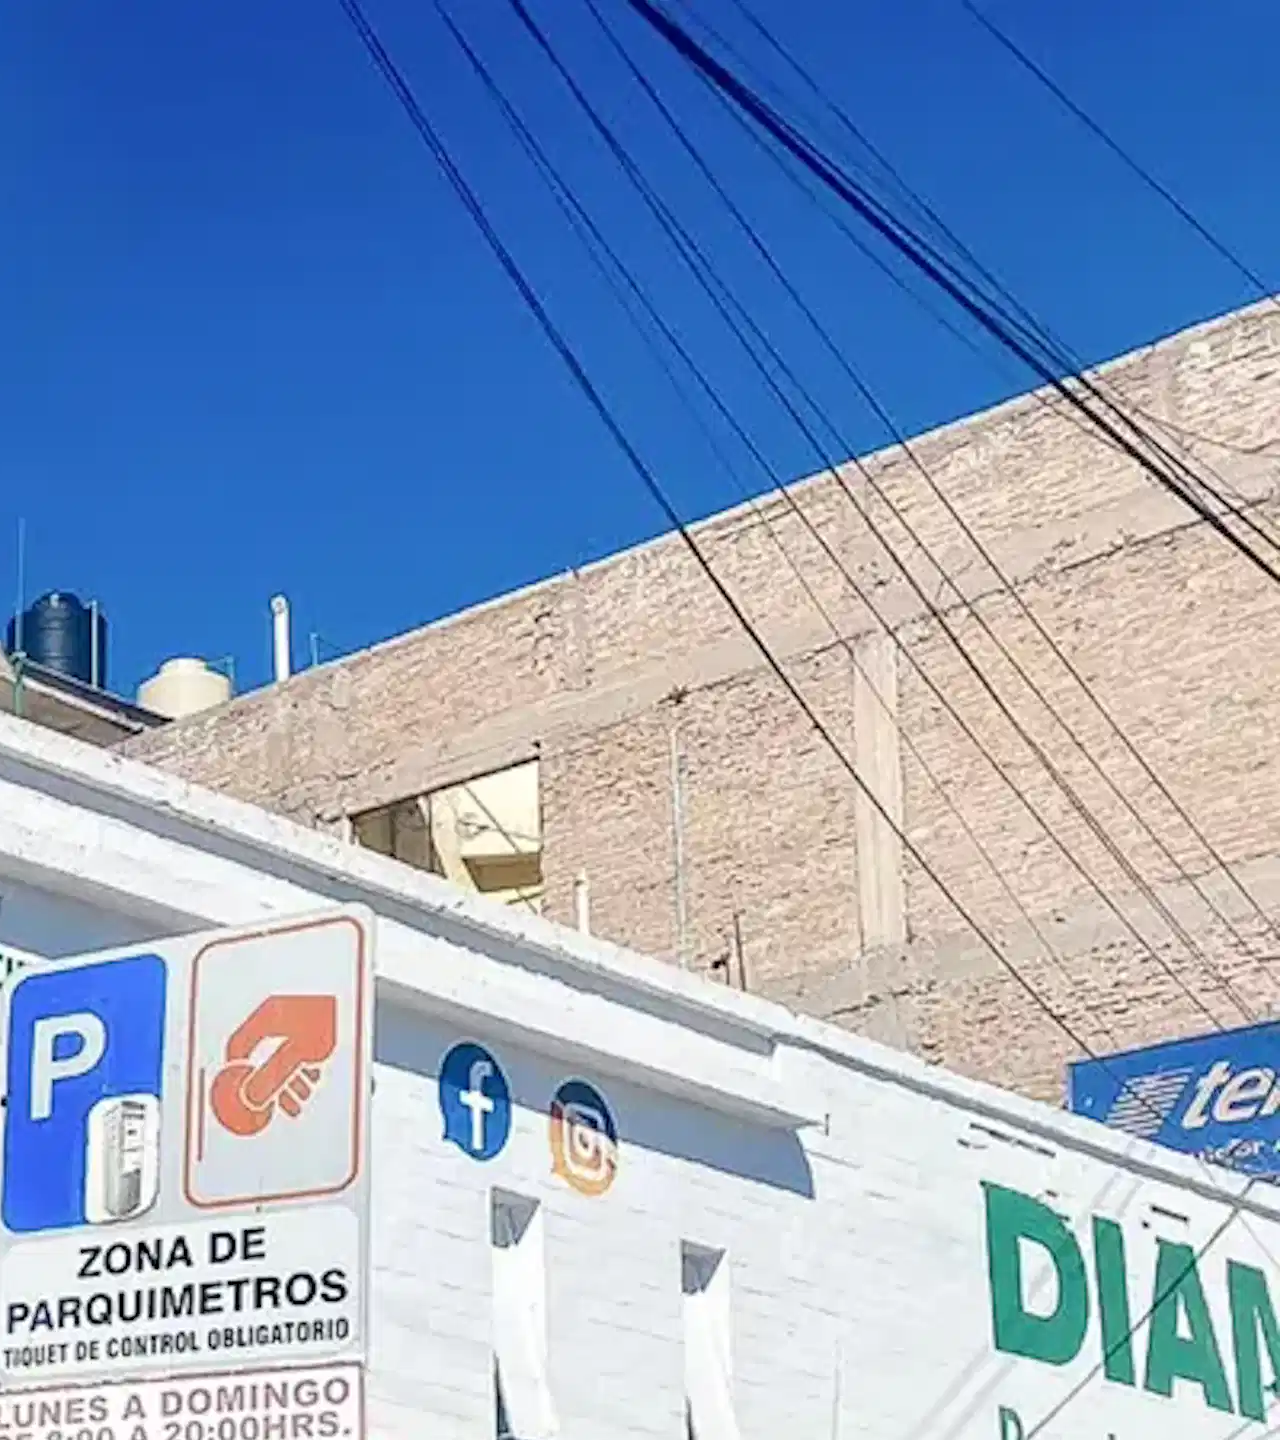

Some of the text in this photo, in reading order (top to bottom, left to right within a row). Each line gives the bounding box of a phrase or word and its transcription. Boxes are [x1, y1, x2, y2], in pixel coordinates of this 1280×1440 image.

[29, 1011, 106, 1120] P
[77, 1227, 268, 1279] ZONA DE
[6, 1268, 349, 1336] PARQUIMETROS
[3, 1318, 351, 1371] TIQUET DE CONTROL OBLIGATORIO
[122, 1393, 147, 1421] A
[159, 1377, 351, 1417] DOMINGO
